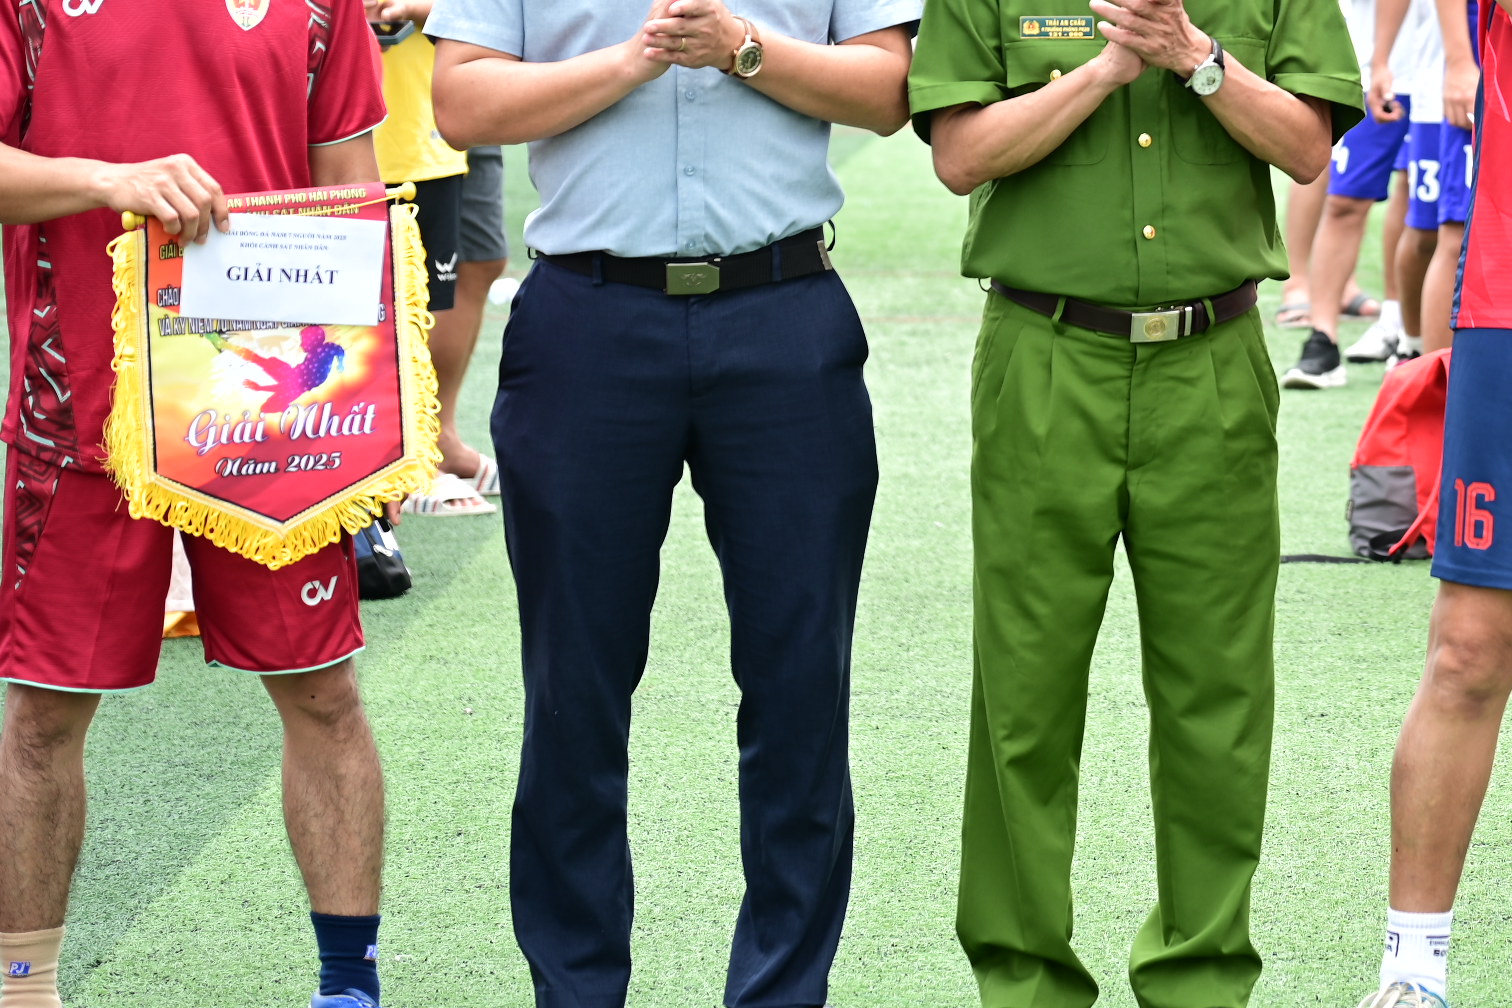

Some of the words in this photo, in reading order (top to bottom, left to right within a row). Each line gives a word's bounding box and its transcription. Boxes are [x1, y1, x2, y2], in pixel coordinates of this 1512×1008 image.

[226, 263, 272, 282] GIẢI
[184, 410, 269, 456] Giải
[280, 402, 377, 440] Nhất
[215, 456, 278, 478] Năm
[285, 451, 342, 473] 2025
[1454, 478, 1496, 550] 16
